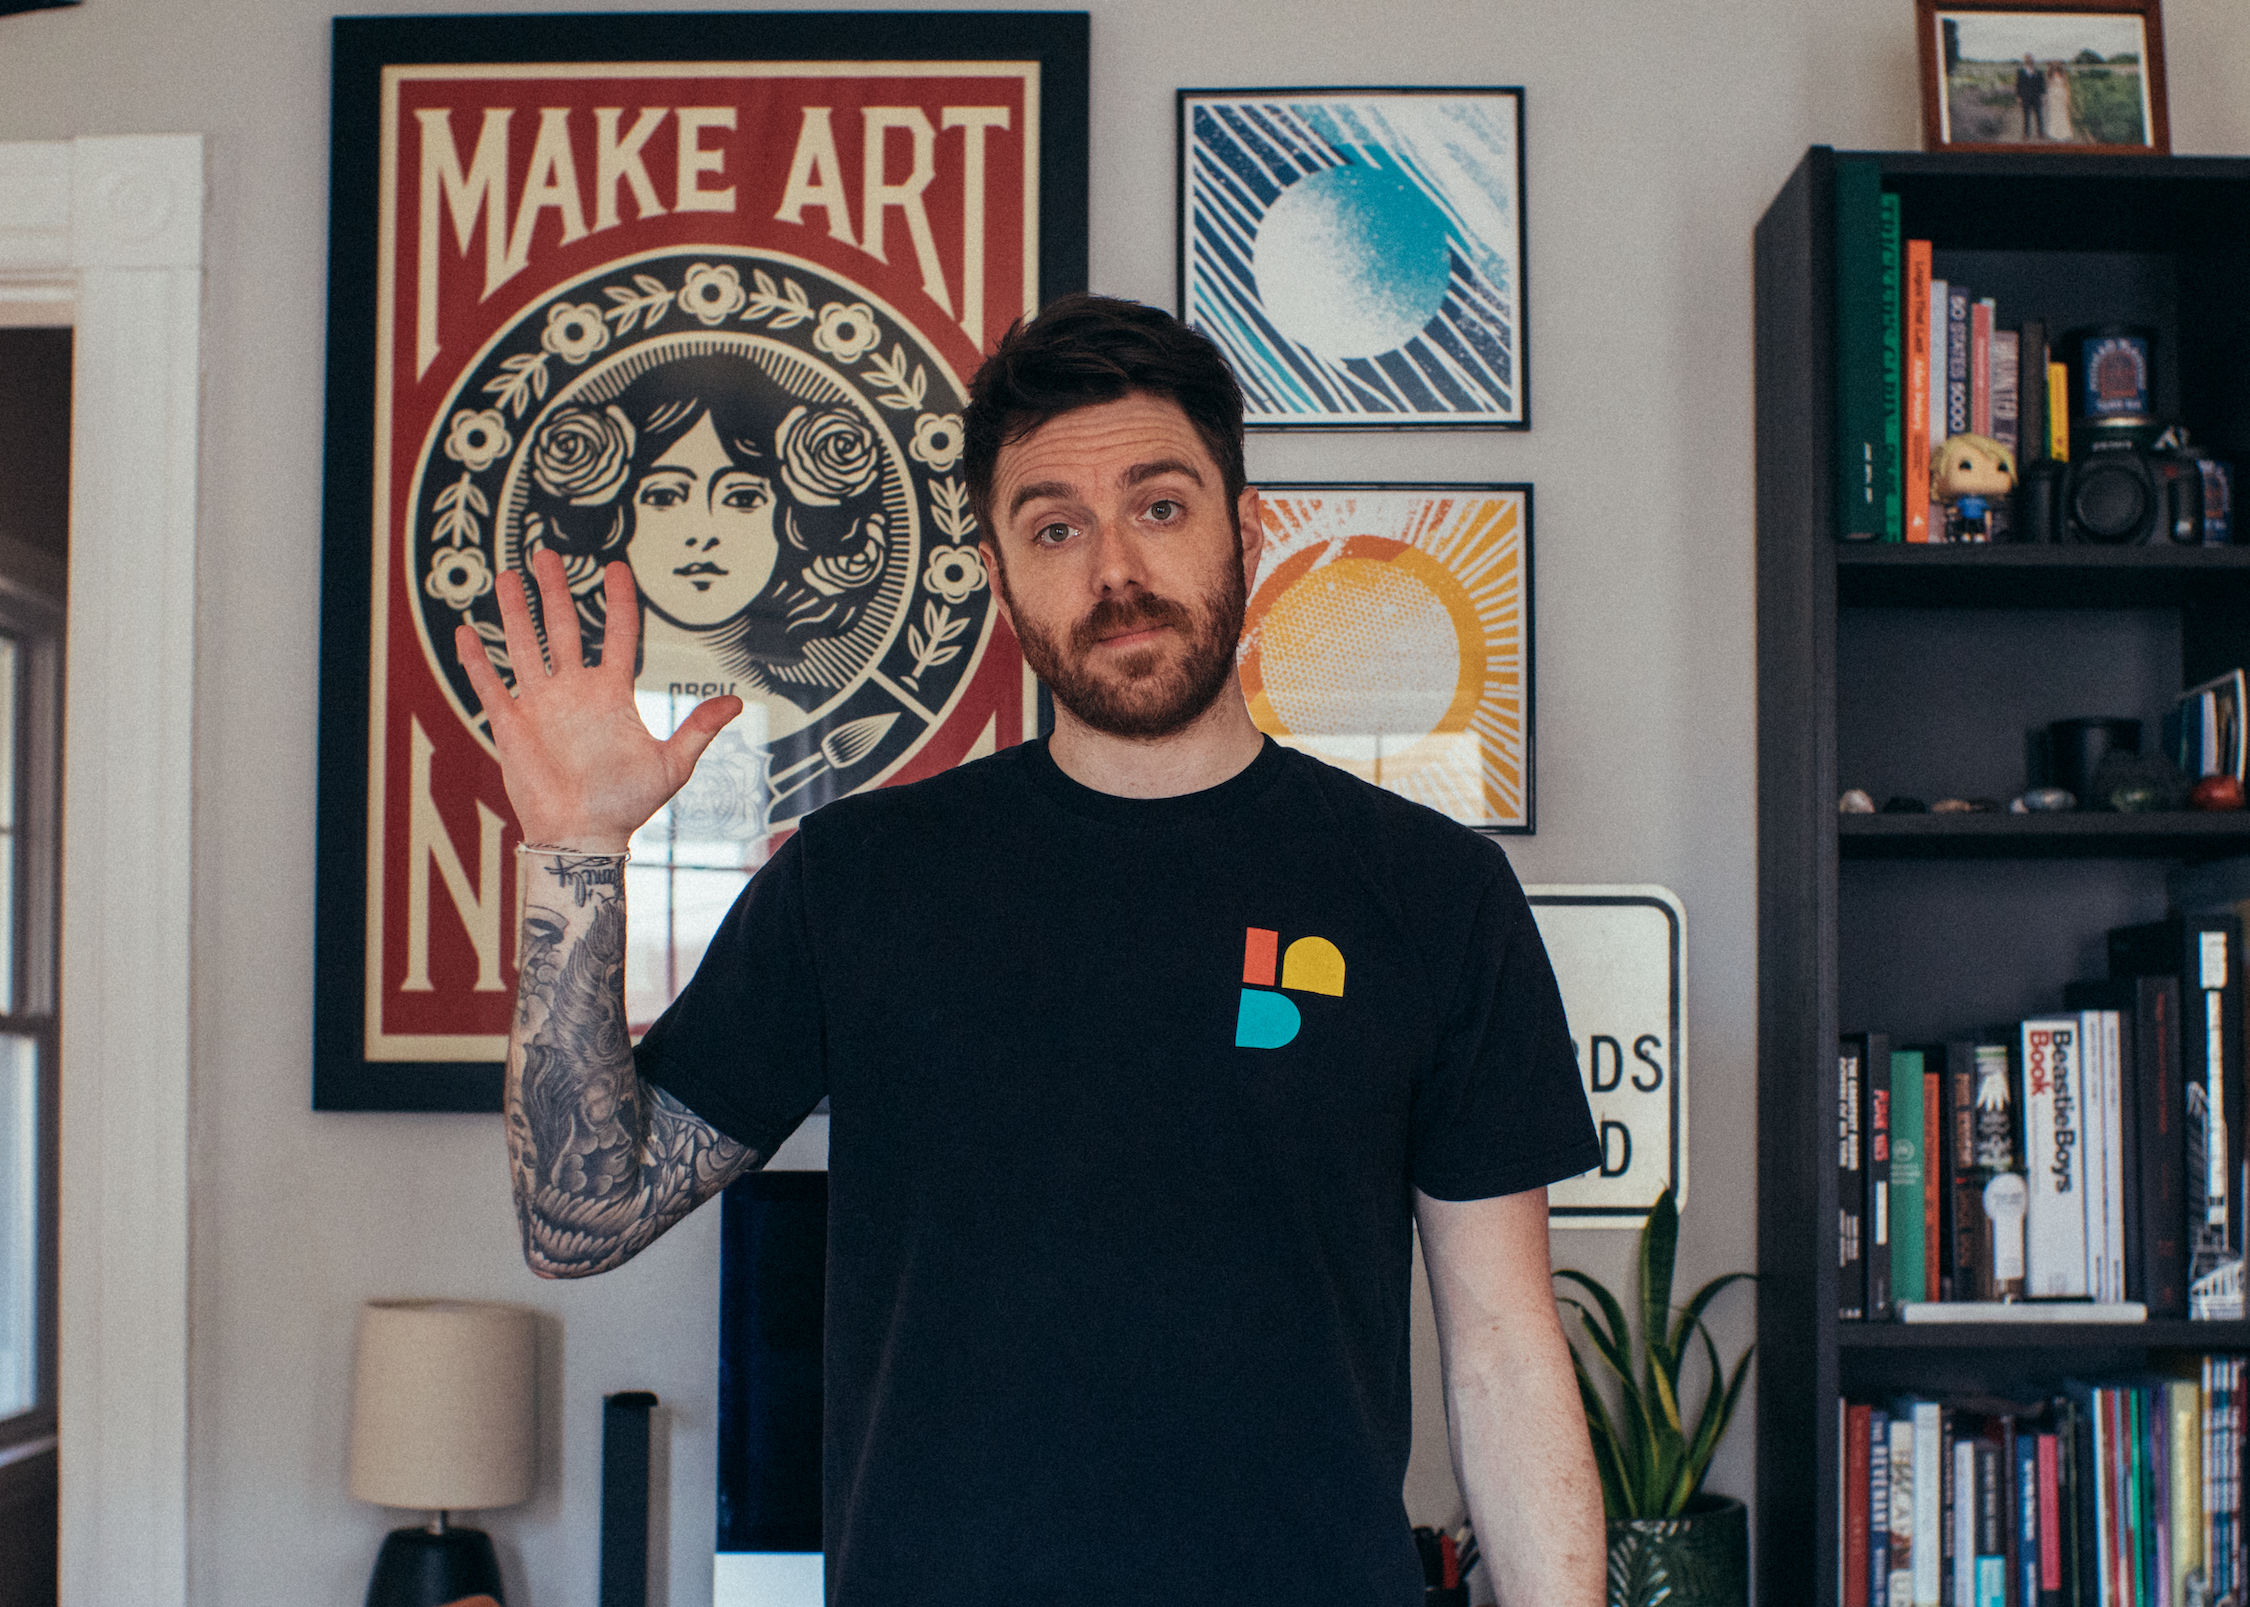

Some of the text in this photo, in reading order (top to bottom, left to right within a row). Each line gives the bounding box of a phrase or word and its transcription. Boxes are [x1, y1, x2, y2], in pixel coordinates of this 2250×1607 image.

[414, 105, 1011, 384] MAKE ART
[1913, 261, 1926, 353] Logos That Last
[1949, 295, 1966, 320] 50
[1949, 322, 1967, 378] STATES
[1571, 1033, 1663, 1093] DS
[2029, 1029, 2052, 1096] Book
[1576, 1120, 1632, 1178] D
[2051, 1130, 2076, 1193] Boys
[1871, 1445, 1888, 1532] REVENANT
